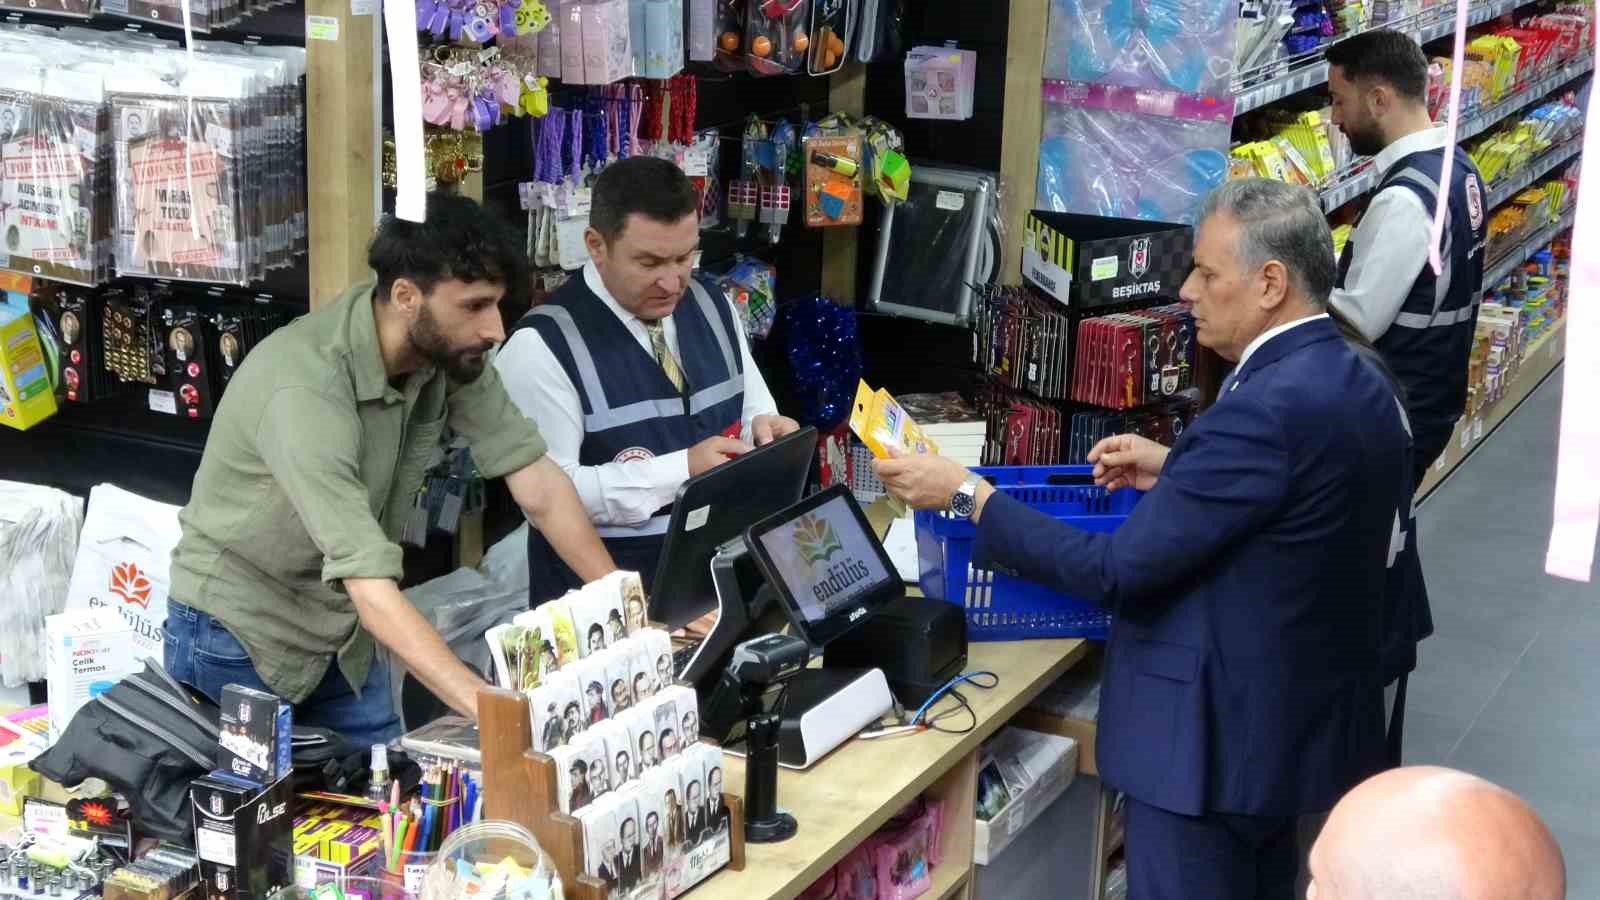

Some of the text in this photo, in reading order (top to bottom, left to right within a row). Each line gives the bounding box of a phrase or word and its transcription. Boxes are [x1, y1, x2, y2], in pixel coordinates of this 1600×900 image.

[1112, 281, 1160, 298] BEŞİKTAŞ
[812, 557, 870, 602] endülüs
[88, 595, 163, 643] eülüs
[72, 665, 107, 675] Termos
